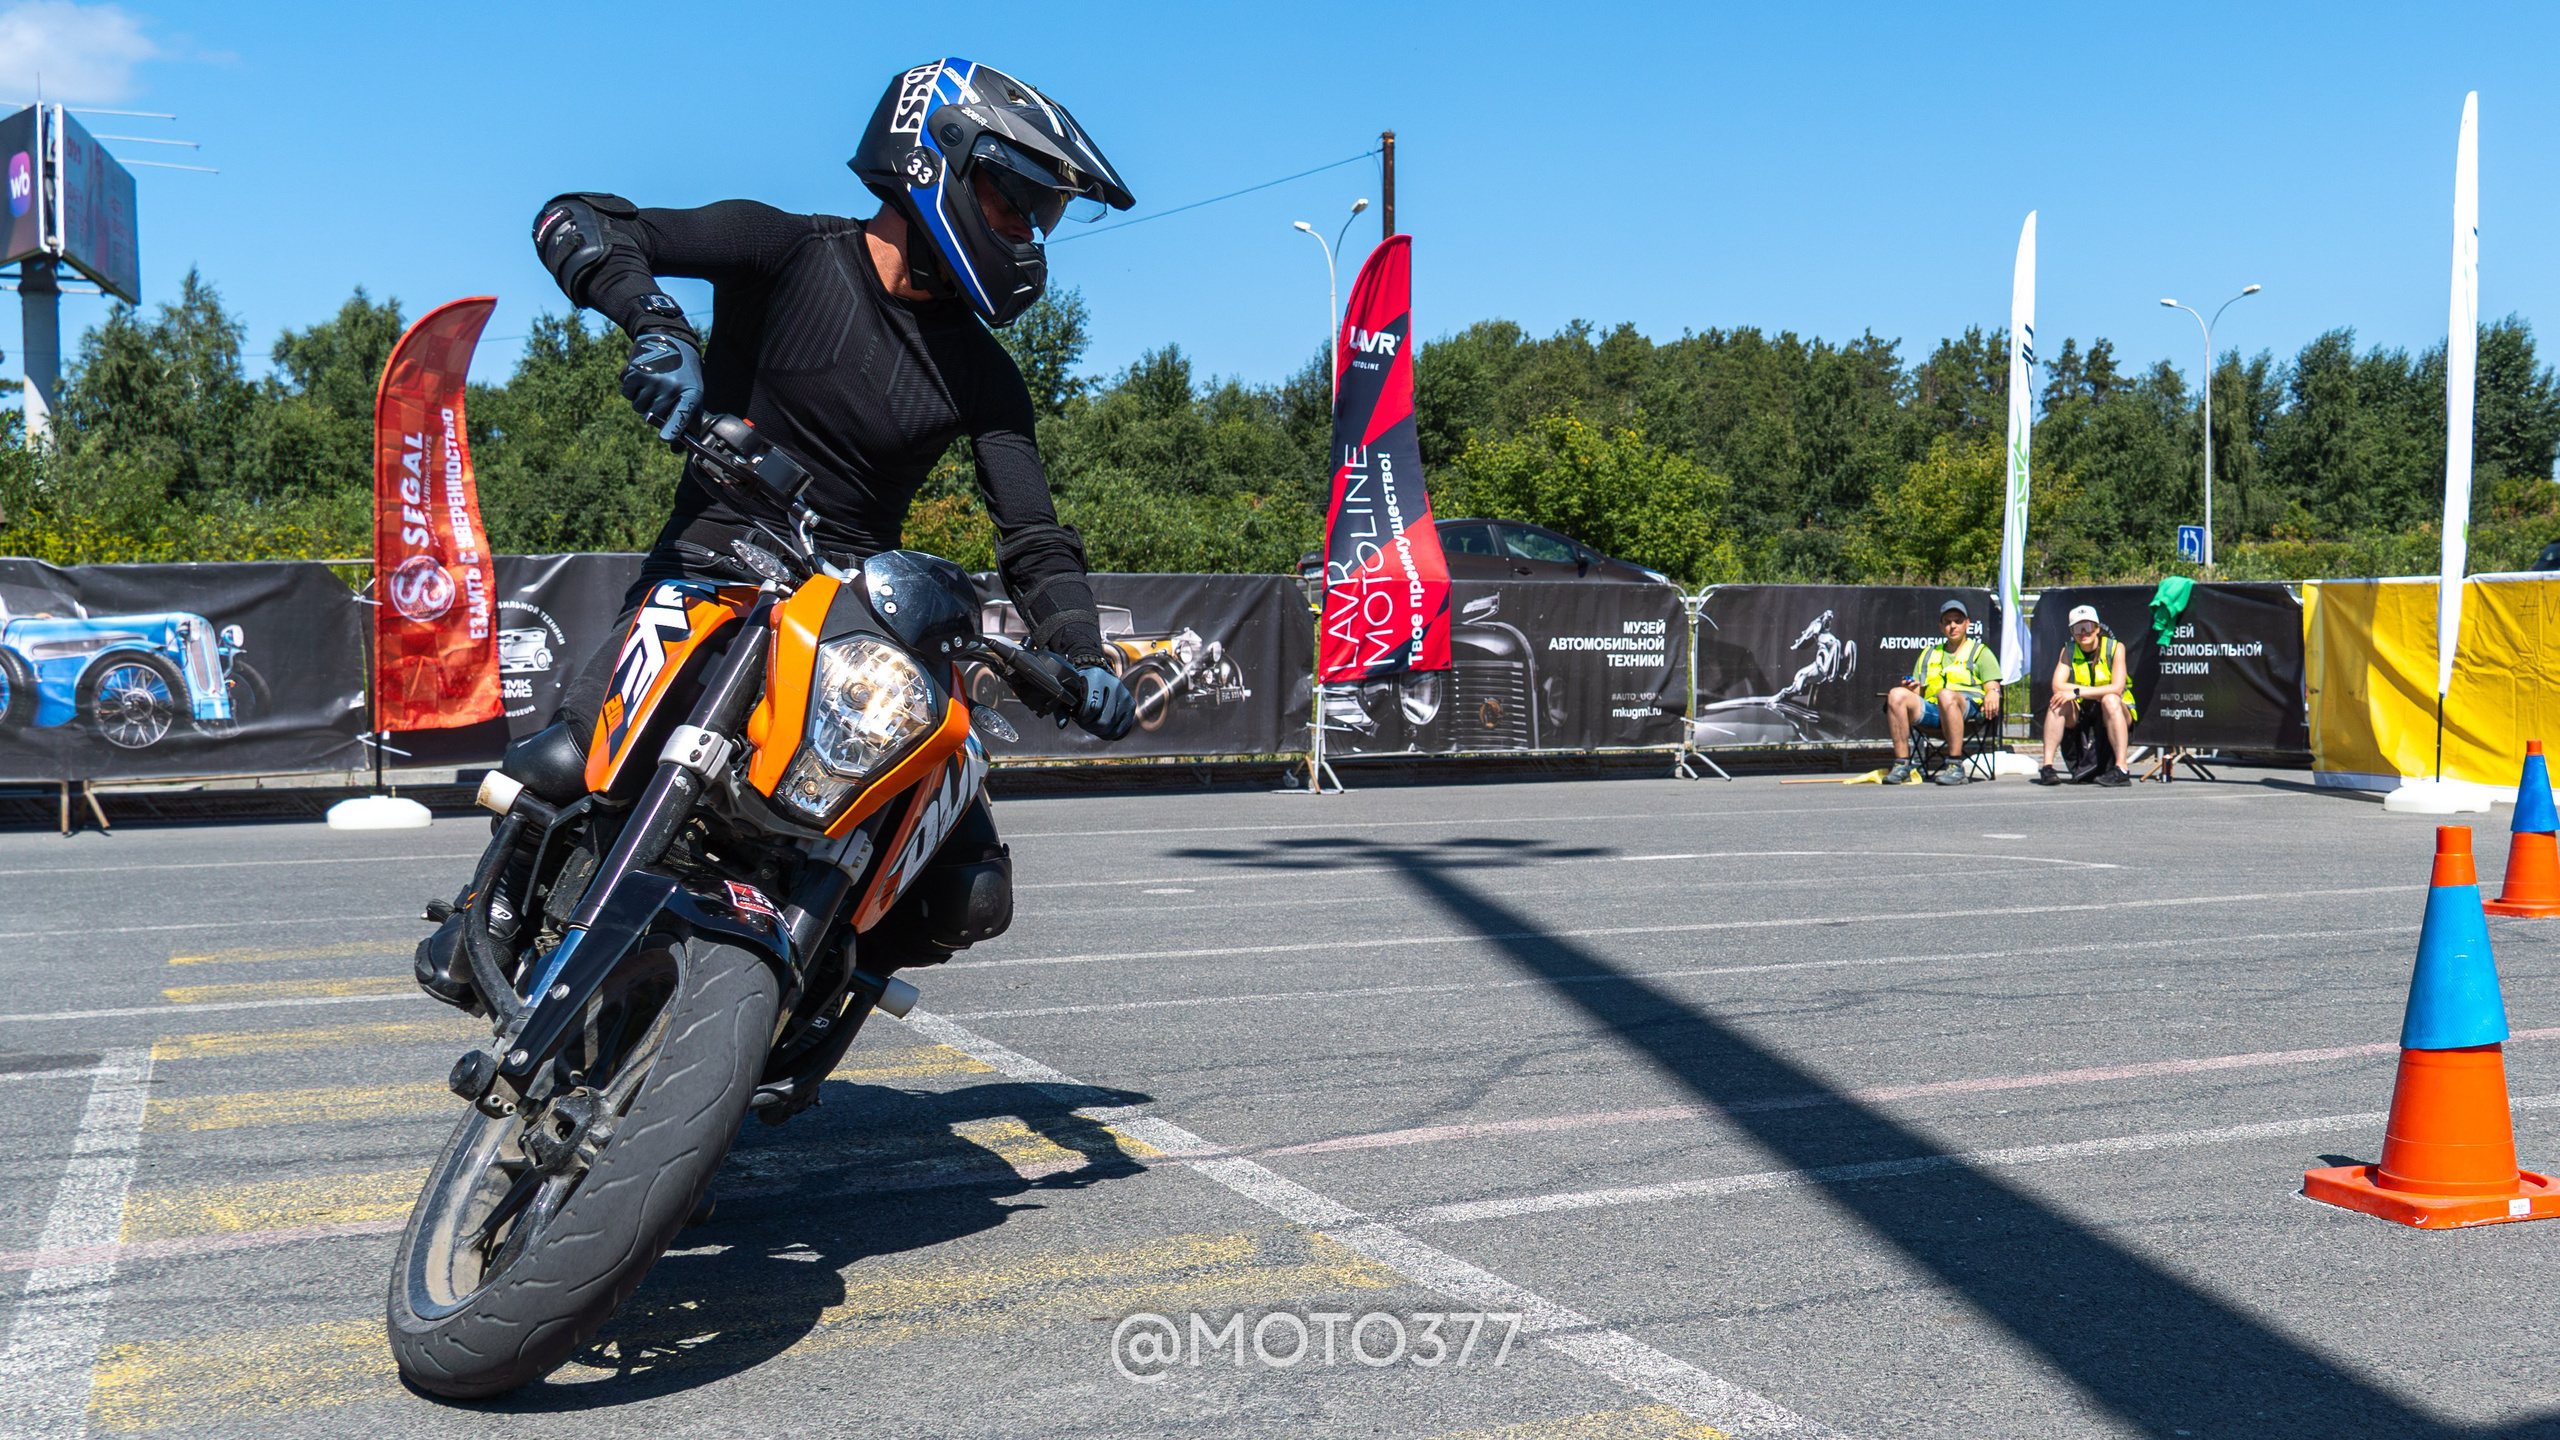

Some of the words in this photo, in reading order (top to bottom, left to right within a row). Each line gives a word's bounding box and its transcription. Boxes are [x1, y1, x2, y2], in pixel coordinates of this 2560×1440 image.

[10, 165, 30, 199] wb
[906, 158, 934, 185] 33
[400, 431, 430, 548] SEGAL
[441, 408, 475, 549] УВЕРЕННОСТЬЮ
[1376, 452, 1426, 608] преимущество!
[1344, 443, 1396, 667] MOTOLINE
[466, 566, 489, 640] ЕЗДИТЬ
[1326, 559, 1360, 671] LAVR
[1408, 613, 1424, 666] Твое
[1548, 635, 1665, 650] АВТОМОБИЛЬНОЙ
[1623, 619, 1666, 634] МУЗЕЙ
[1607, 654, 1664, 667] ТЕХНИКИ
[2159, 640, 2263, 656] АВТОМОБИЛЬНОЙ
[2159, 662, 2209, 674] ТЕХНИКИ
[1611, 692, 1662, 702] #AUTO_UG
